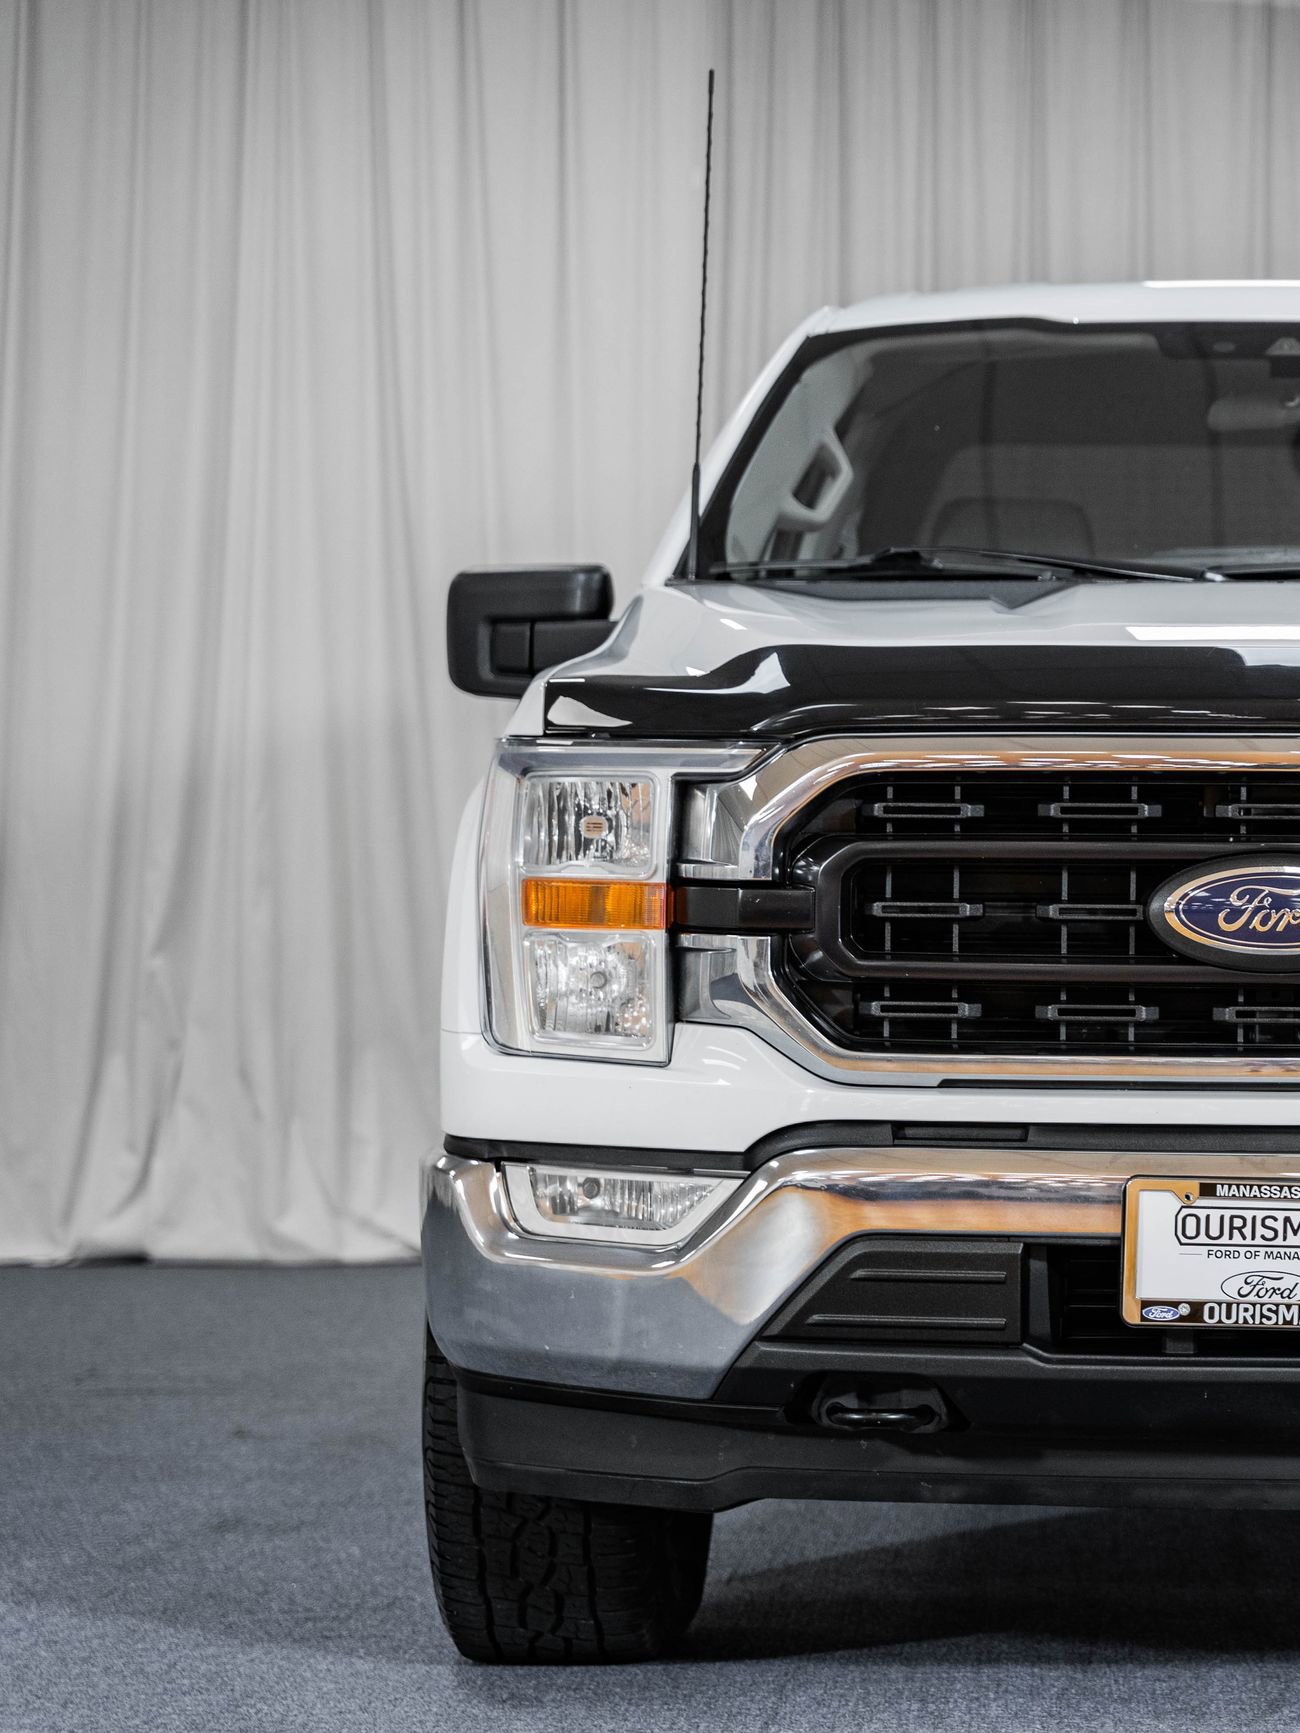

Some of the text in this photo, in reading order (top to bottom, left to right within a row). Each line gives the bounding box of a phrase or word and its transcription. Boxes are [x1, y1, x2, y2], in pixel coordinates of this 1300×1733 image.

[1206, 1249, 1241, 1260] FORD
[1244, 1250, 1261, 1260] OF
[1237, 1273, 1298, 1300] Ford
[1148, 1307, 1175, 1318] Ford
